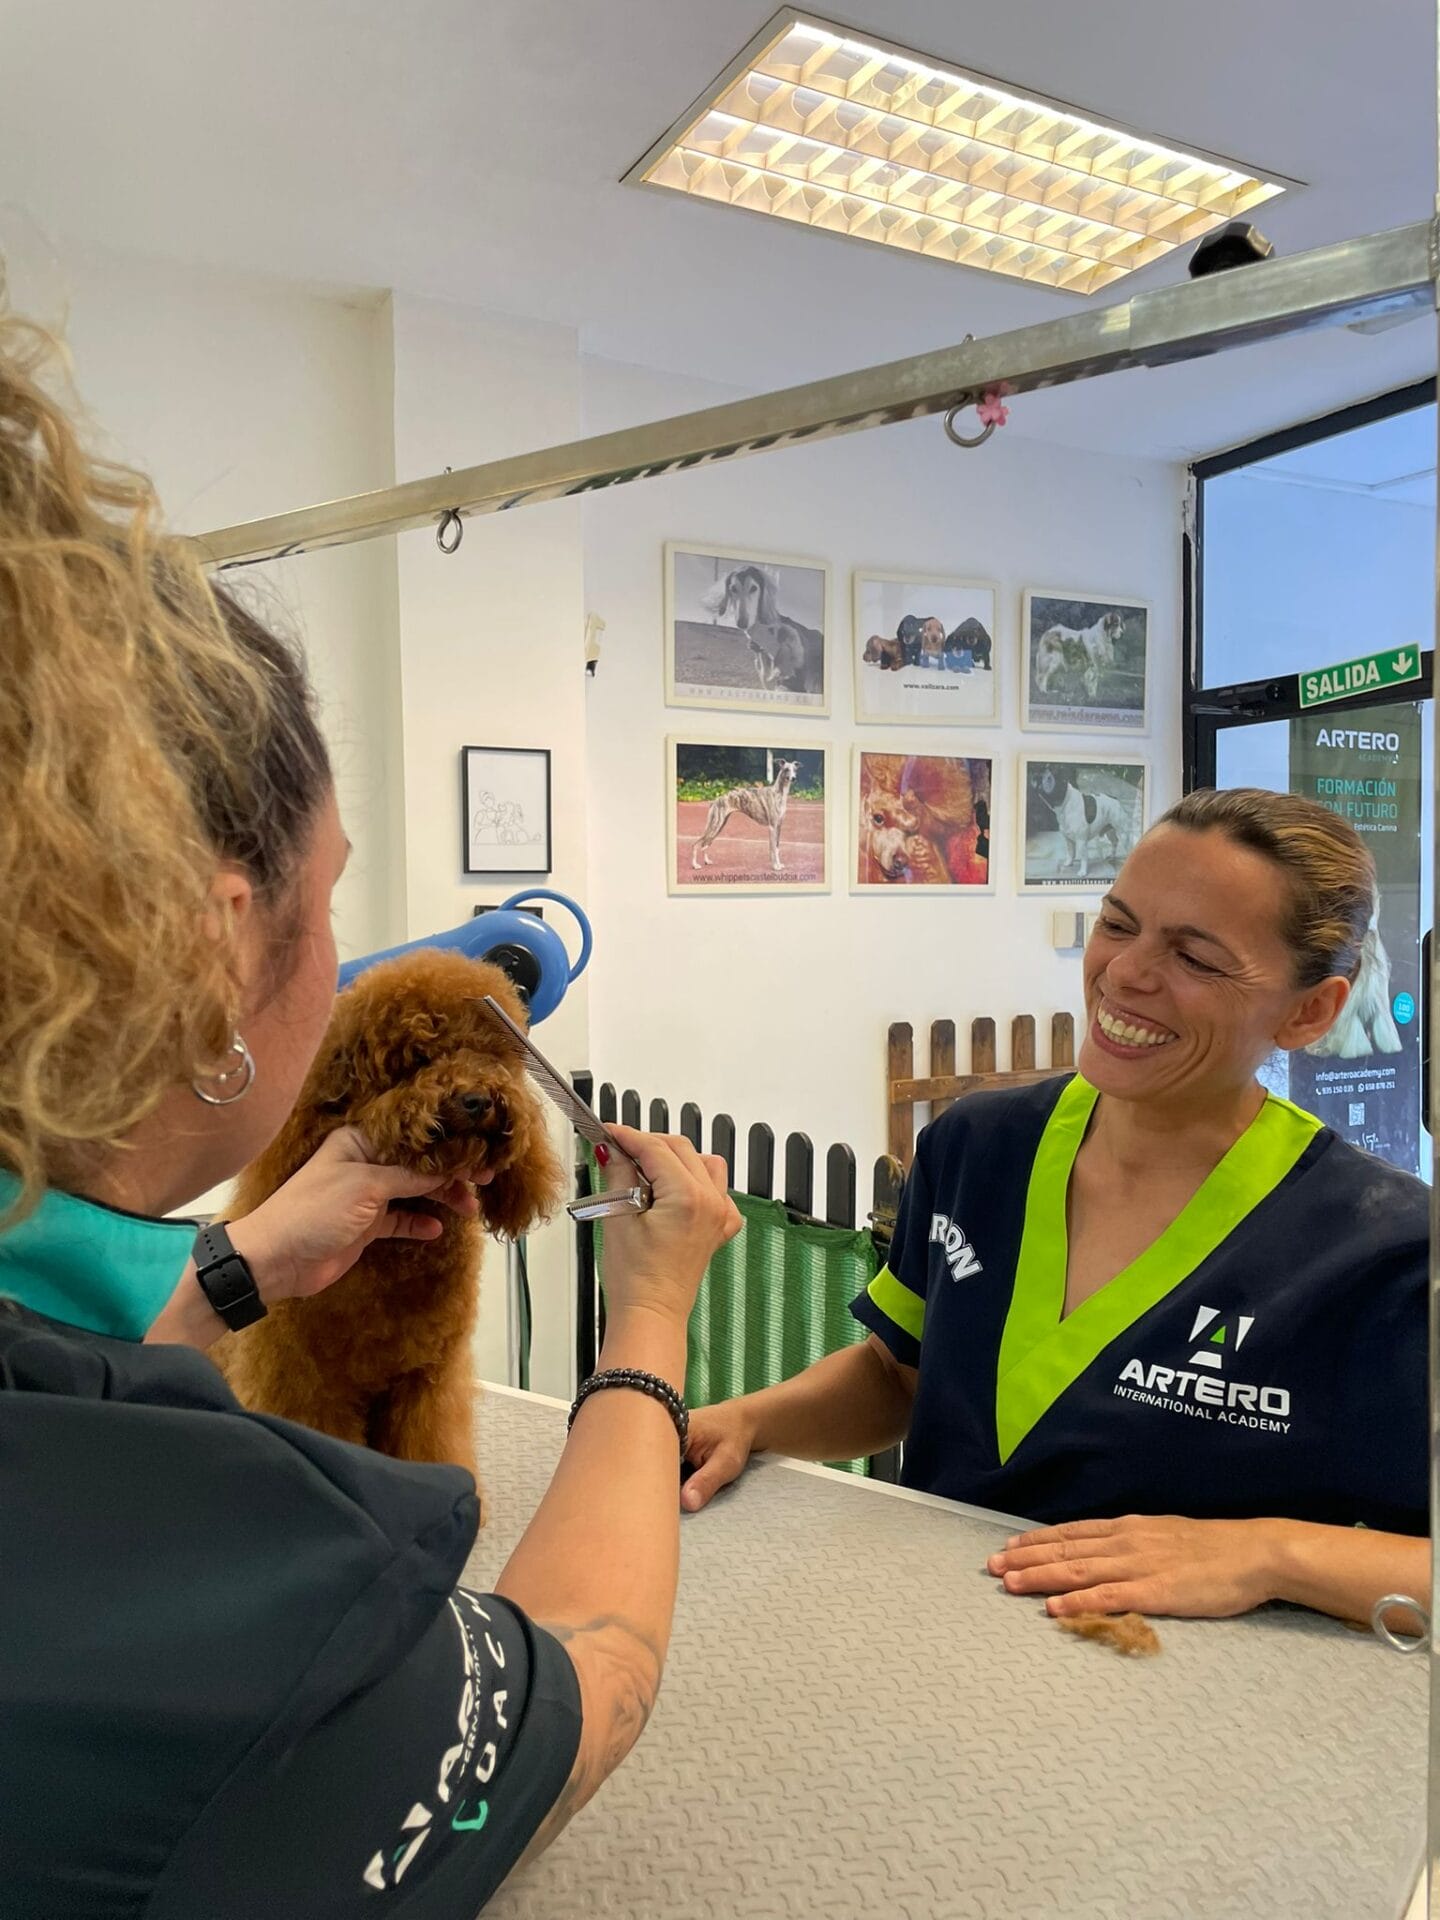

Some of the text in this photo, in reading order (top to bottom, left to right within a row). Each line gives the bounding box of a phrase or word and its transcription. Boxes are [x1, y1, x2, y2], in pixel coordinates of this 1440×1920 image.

[1306, 660, 1380, 700] SALIDA
[1316, 728, 1399, 751] ARTERO
[1317, 777, 1396, 797] FORMACIÓN
[1347, 802, 1398, 819] FUTURO
[1315, 1068, 1396, 1082] info@arteroacademy.com
[1118, 1358, 1291, 1417] ARTERO
[1113, 1384, 1291, 1434] INTERNATIONAL ACADEMY
